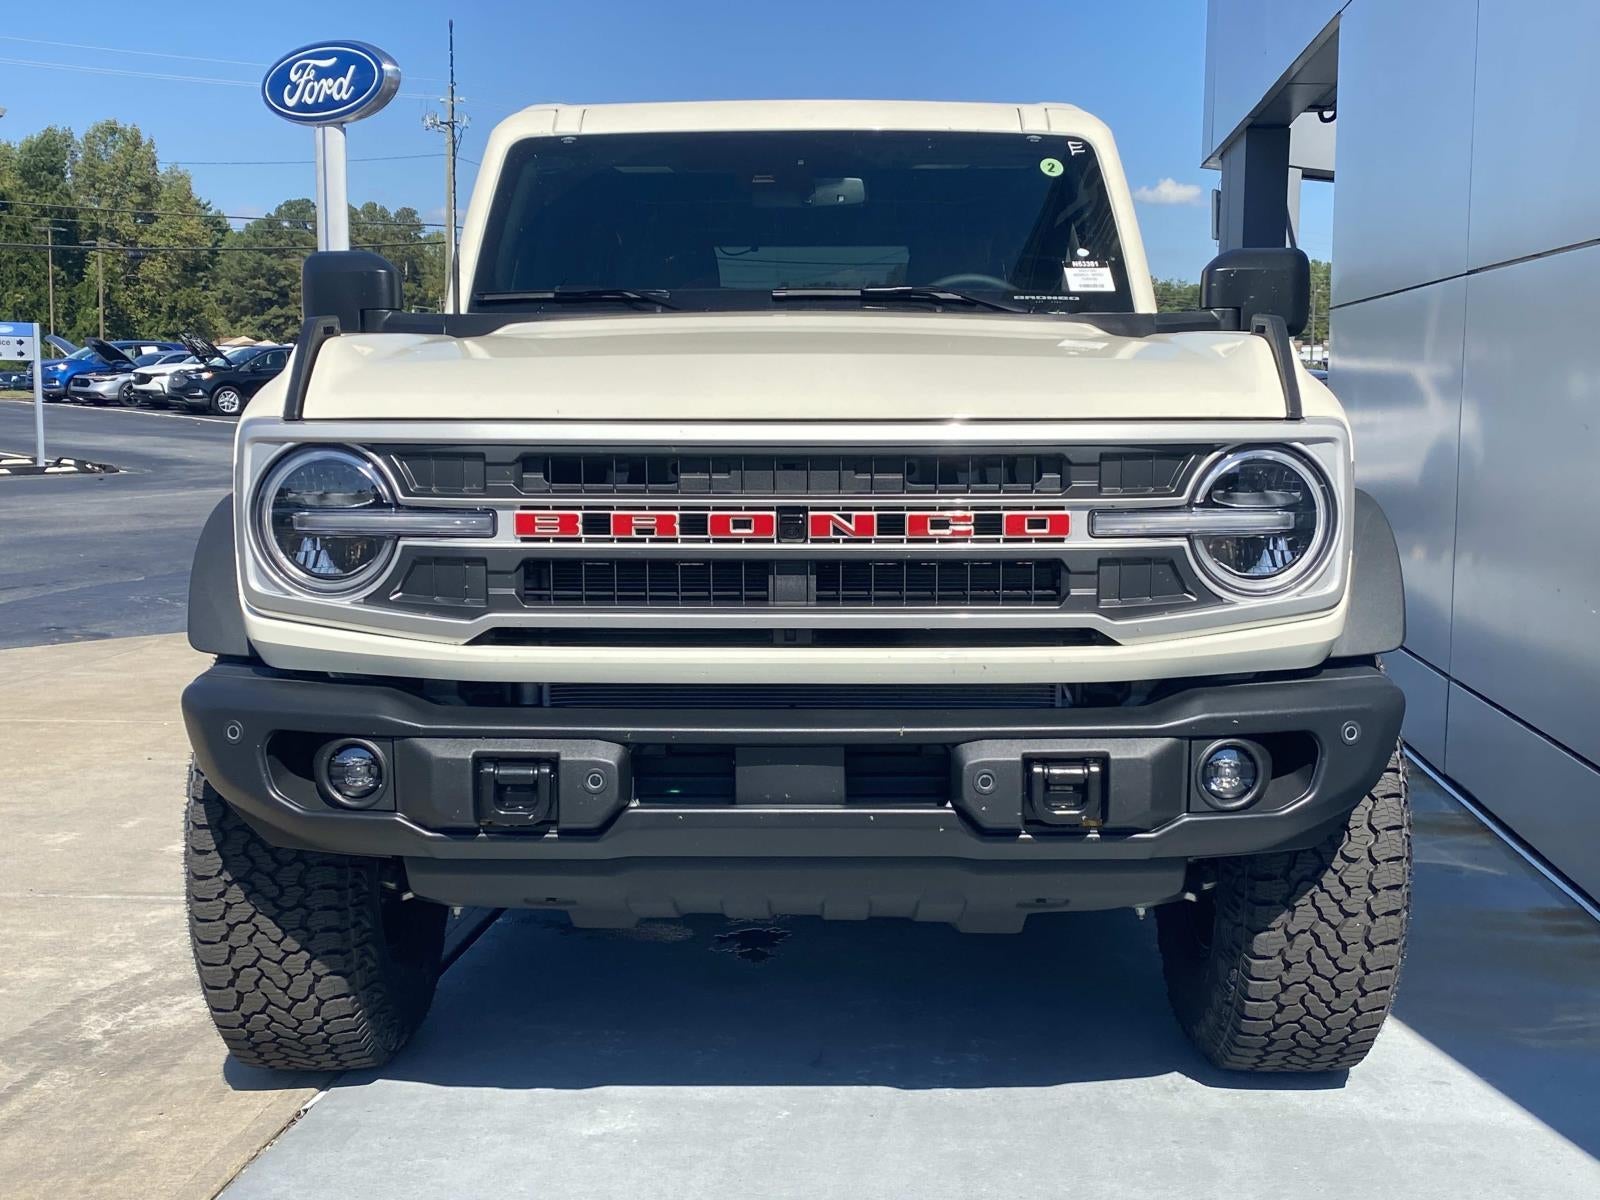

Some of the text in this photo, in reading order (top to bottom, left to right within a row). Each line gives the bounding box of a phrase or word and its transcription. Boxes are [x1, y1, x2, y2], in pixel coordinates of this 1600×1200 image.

[283, 56, 356, 108] Ford
[1047, 162, 1056, 173] 2
[513, 510, 1072, 539] BRONCO
